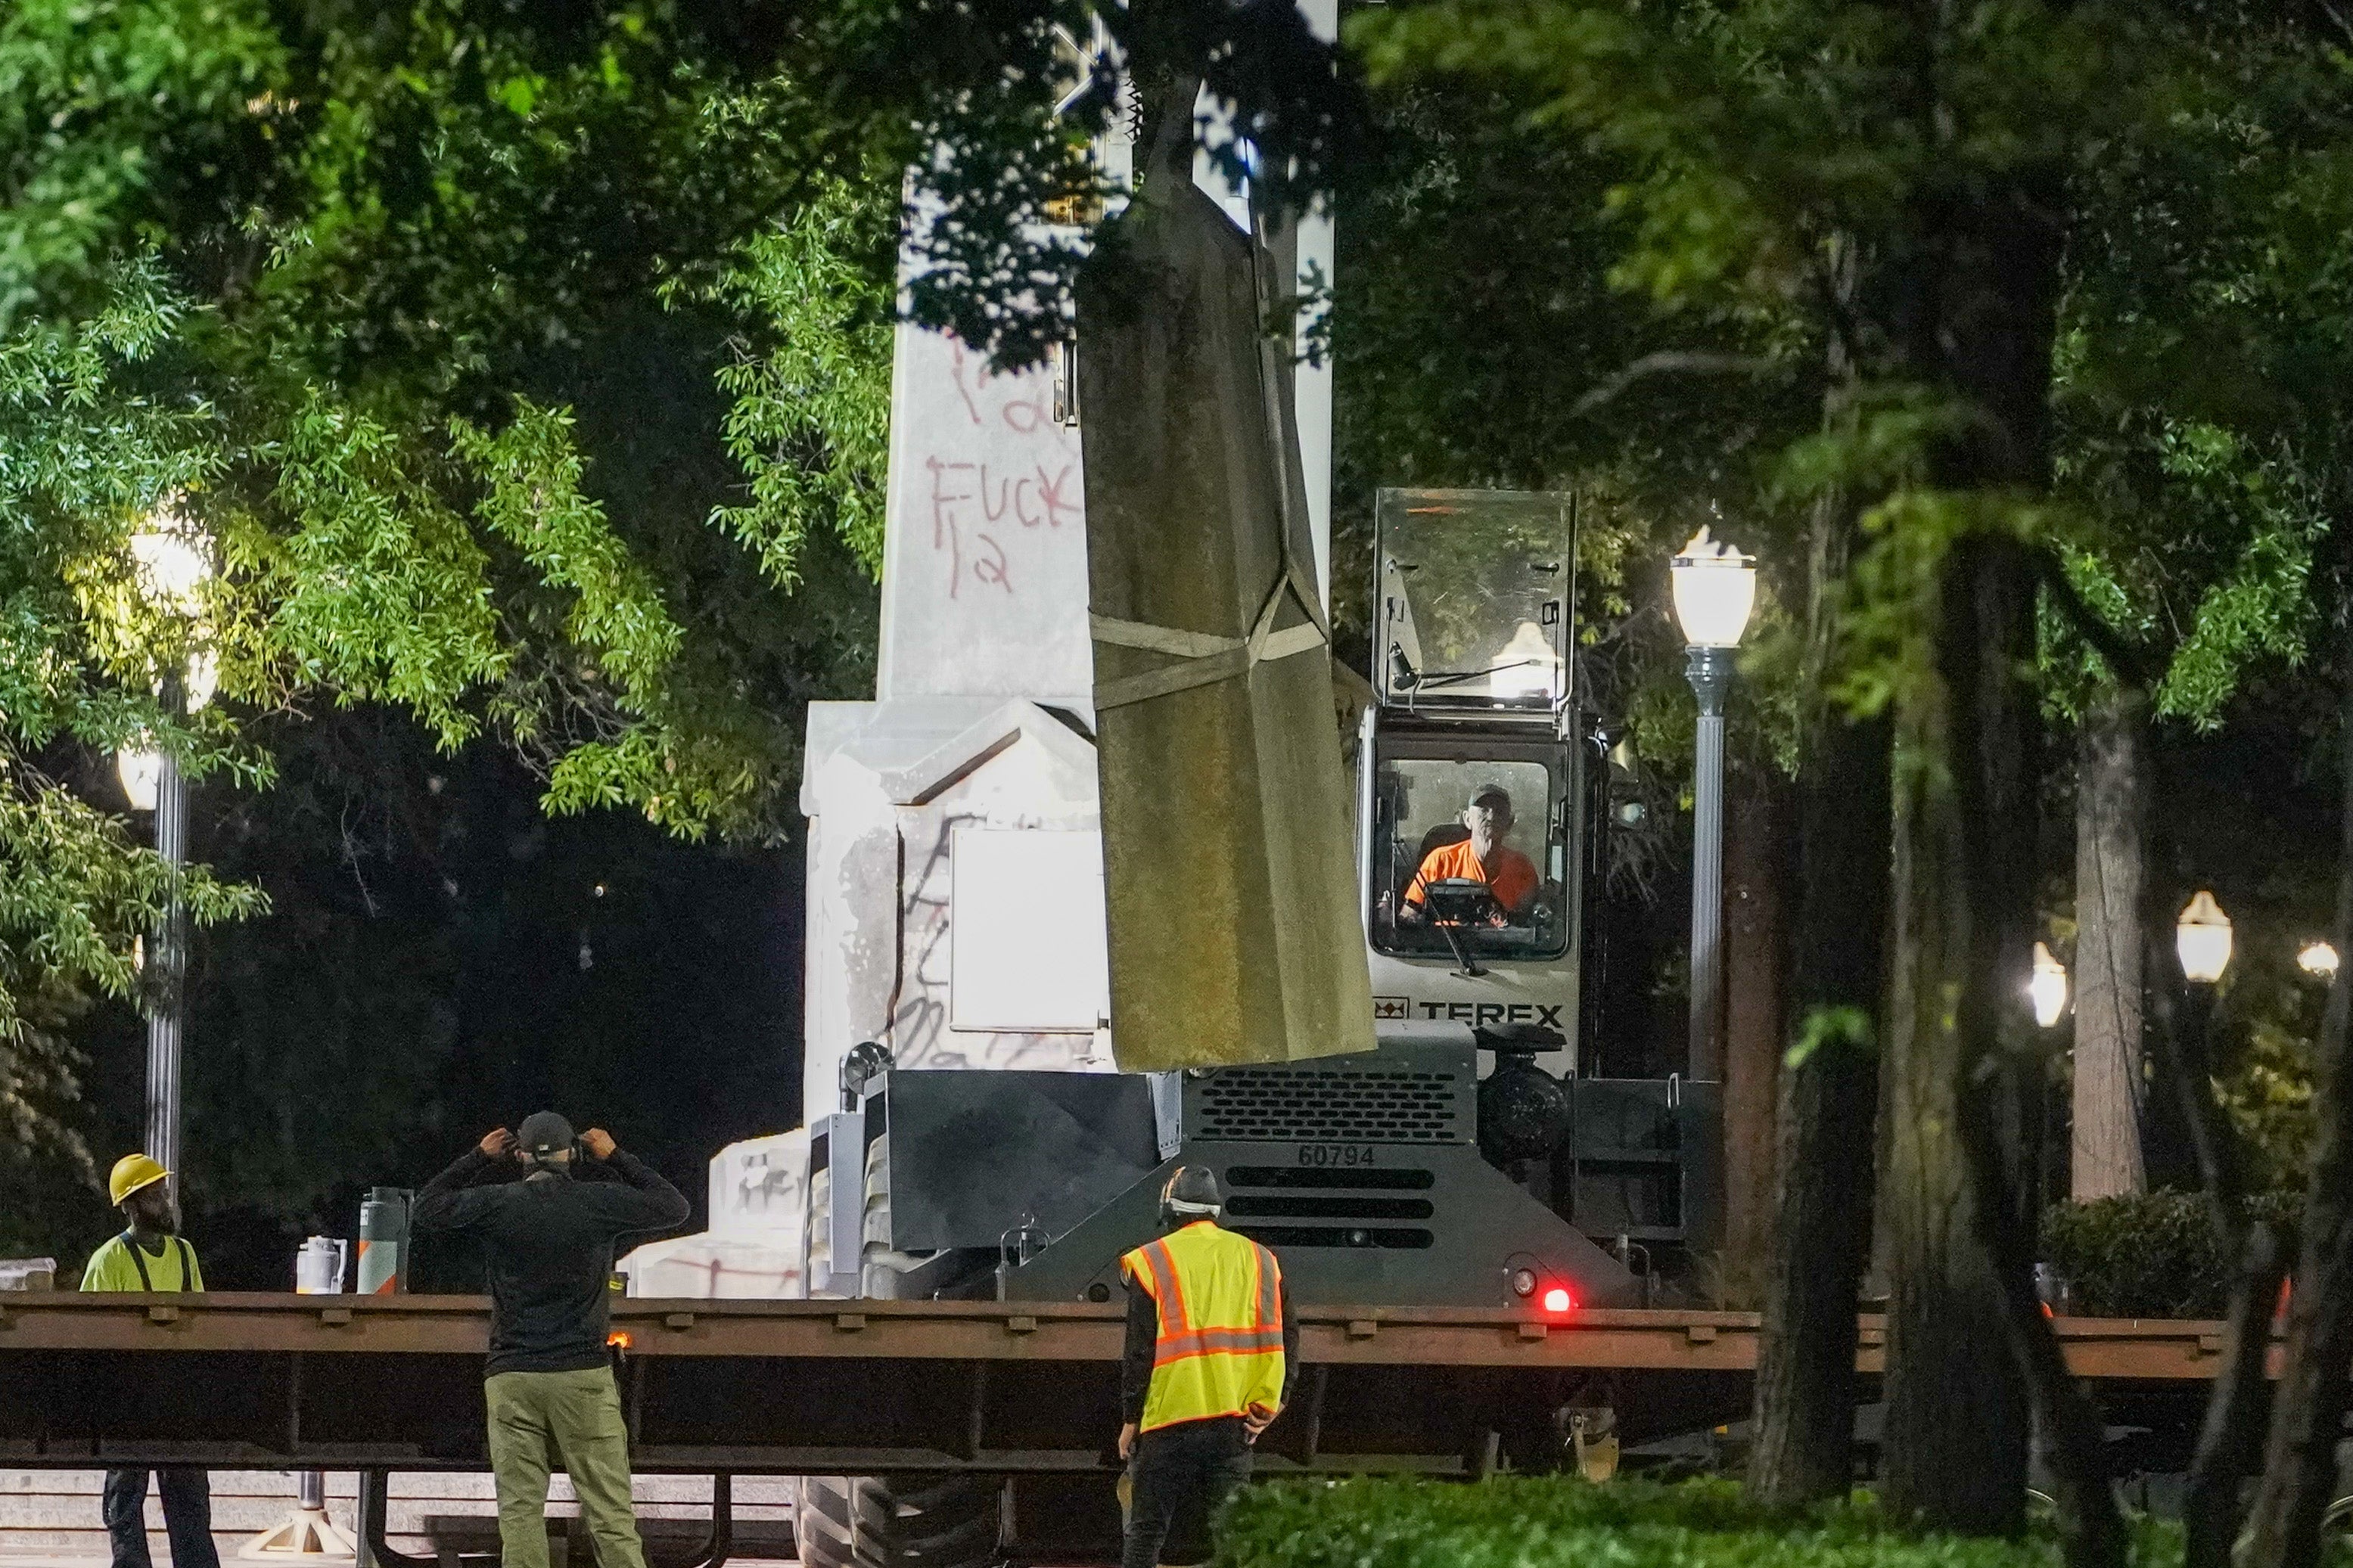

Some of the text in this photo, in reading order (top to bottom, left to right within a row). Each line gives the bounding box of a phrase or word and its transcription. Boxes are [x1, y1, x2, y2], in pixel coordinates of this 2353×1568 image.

[927, 456, 1083, 549] FUCK
[1419, 1002, 1564, 1029] TEREX
[1298, 1144, 1375, 1166] 60794
